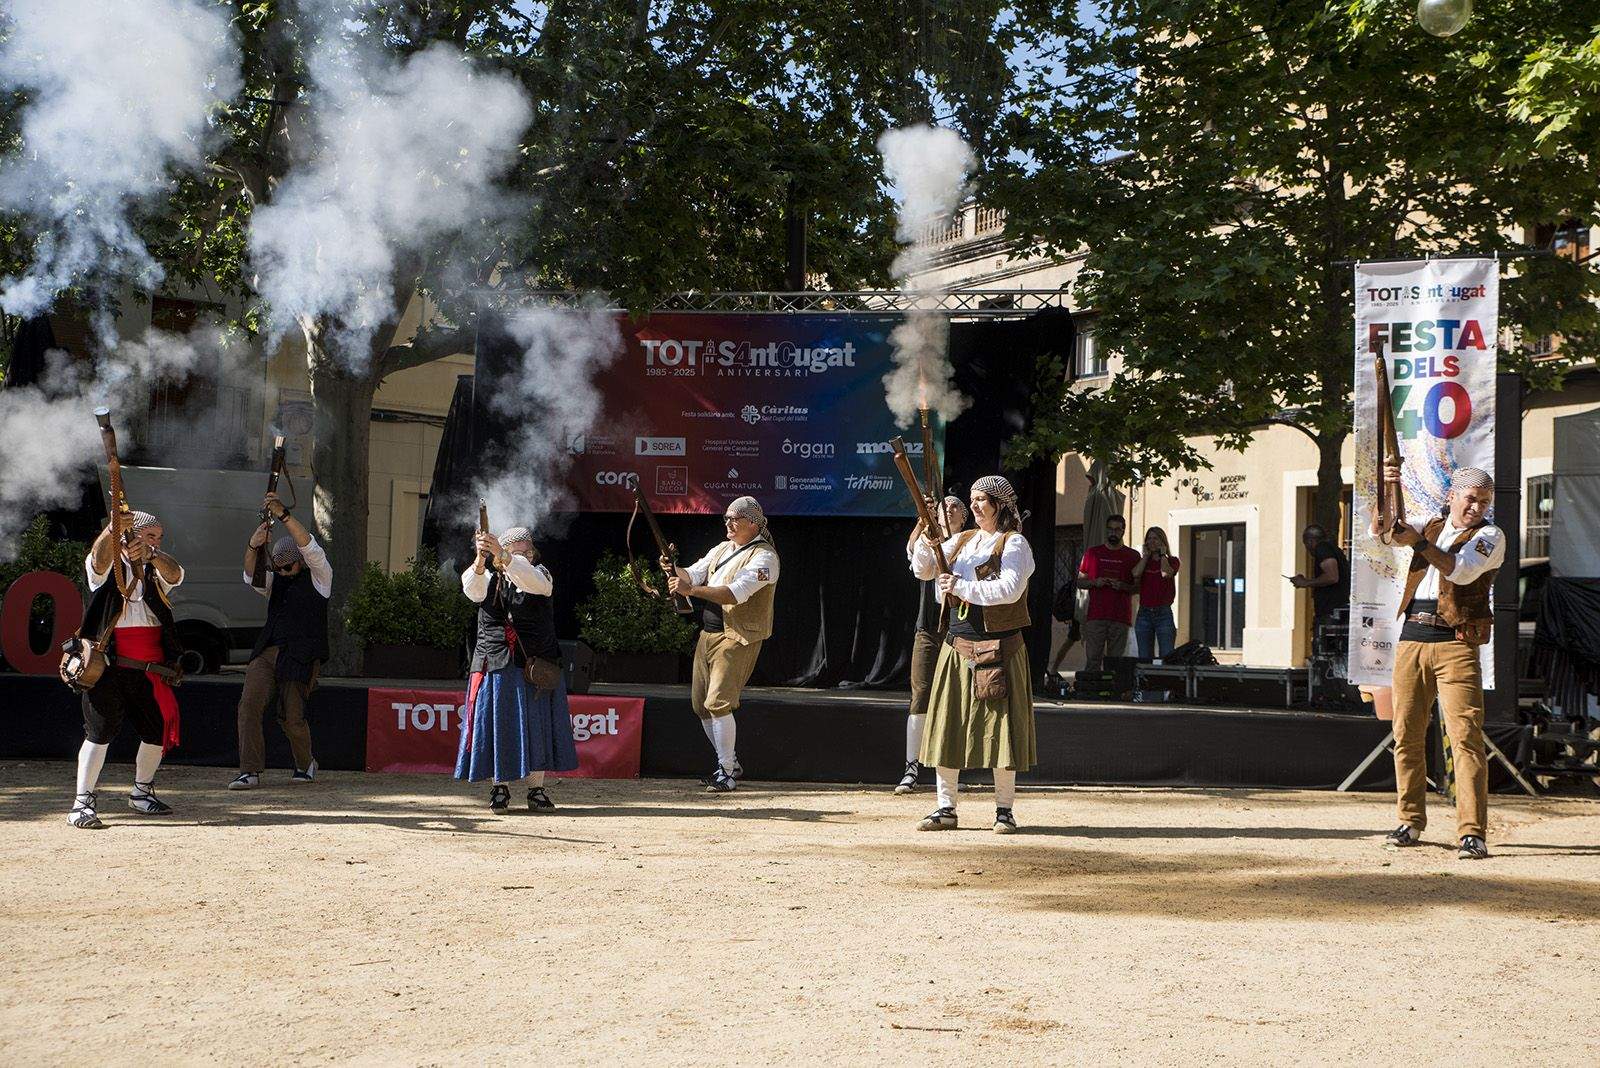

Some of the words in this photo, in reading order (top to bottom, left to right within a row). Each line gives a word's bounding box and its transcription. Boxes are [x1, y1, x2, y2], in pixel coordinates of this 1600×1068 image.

[1367, 287, 1402, 301] TOT
[1369, 320, 1487, 353] FESTA
[640, 340, 703, 366] TOT
[646, 368, 667, 376] 1985
[674, 368, 696, 376] 2025
[717, 368, 808, 377] ANIVERSARI
[1394, 355, 1461, 380] DELS
[1390, 381, 1472, 440] 40
[652, 442, 681, 451] SOREA
[1220, 483, 1239, 492] MUSIC
[1219, 491, 1249, 500] ACADEMY
[391, 702, 454, 731] TOT
